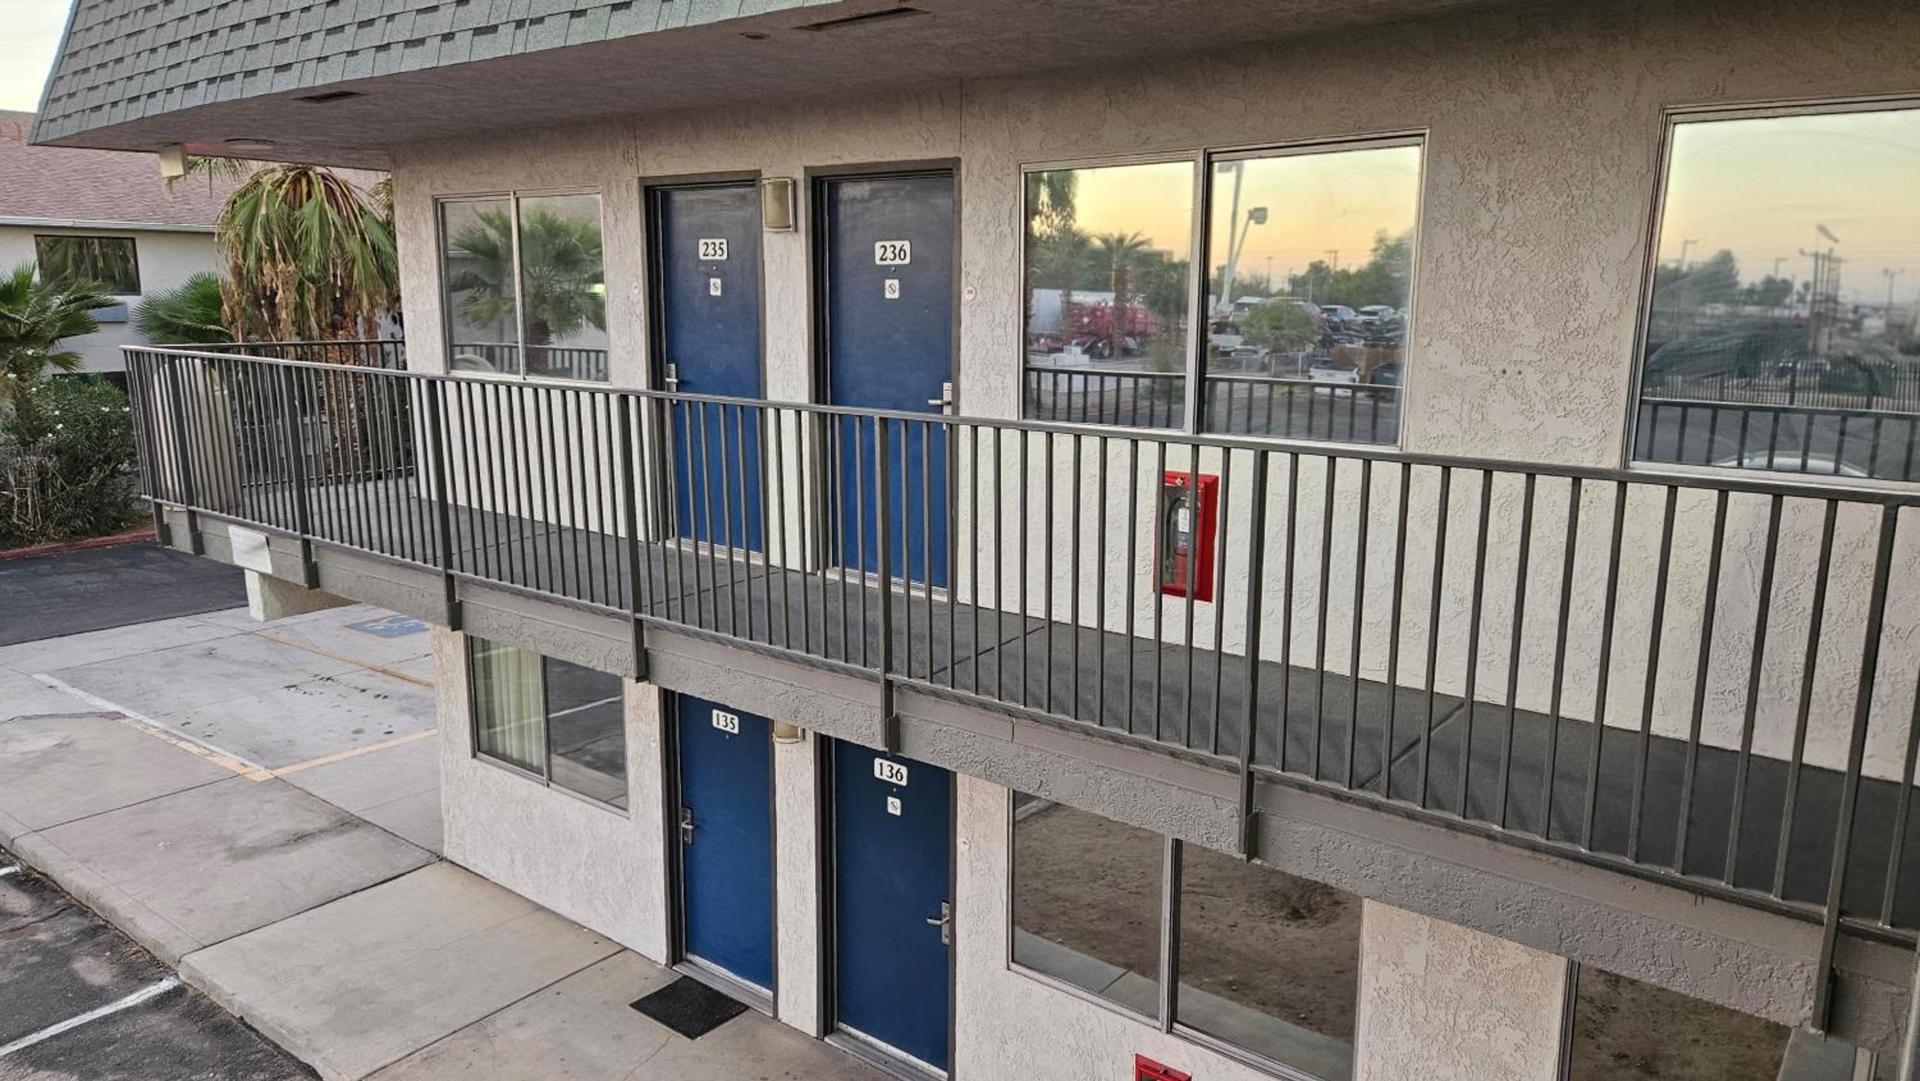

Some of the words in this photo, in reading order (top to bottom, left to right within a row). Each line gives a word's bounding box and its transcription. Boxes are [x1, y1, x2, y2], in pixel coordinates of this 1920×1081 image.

[702, 241, 725, 257] 235
[879, 244, 907, 261] 236
[716, 712, 736, 731] 135
[878, 762, 904, 782] 136
